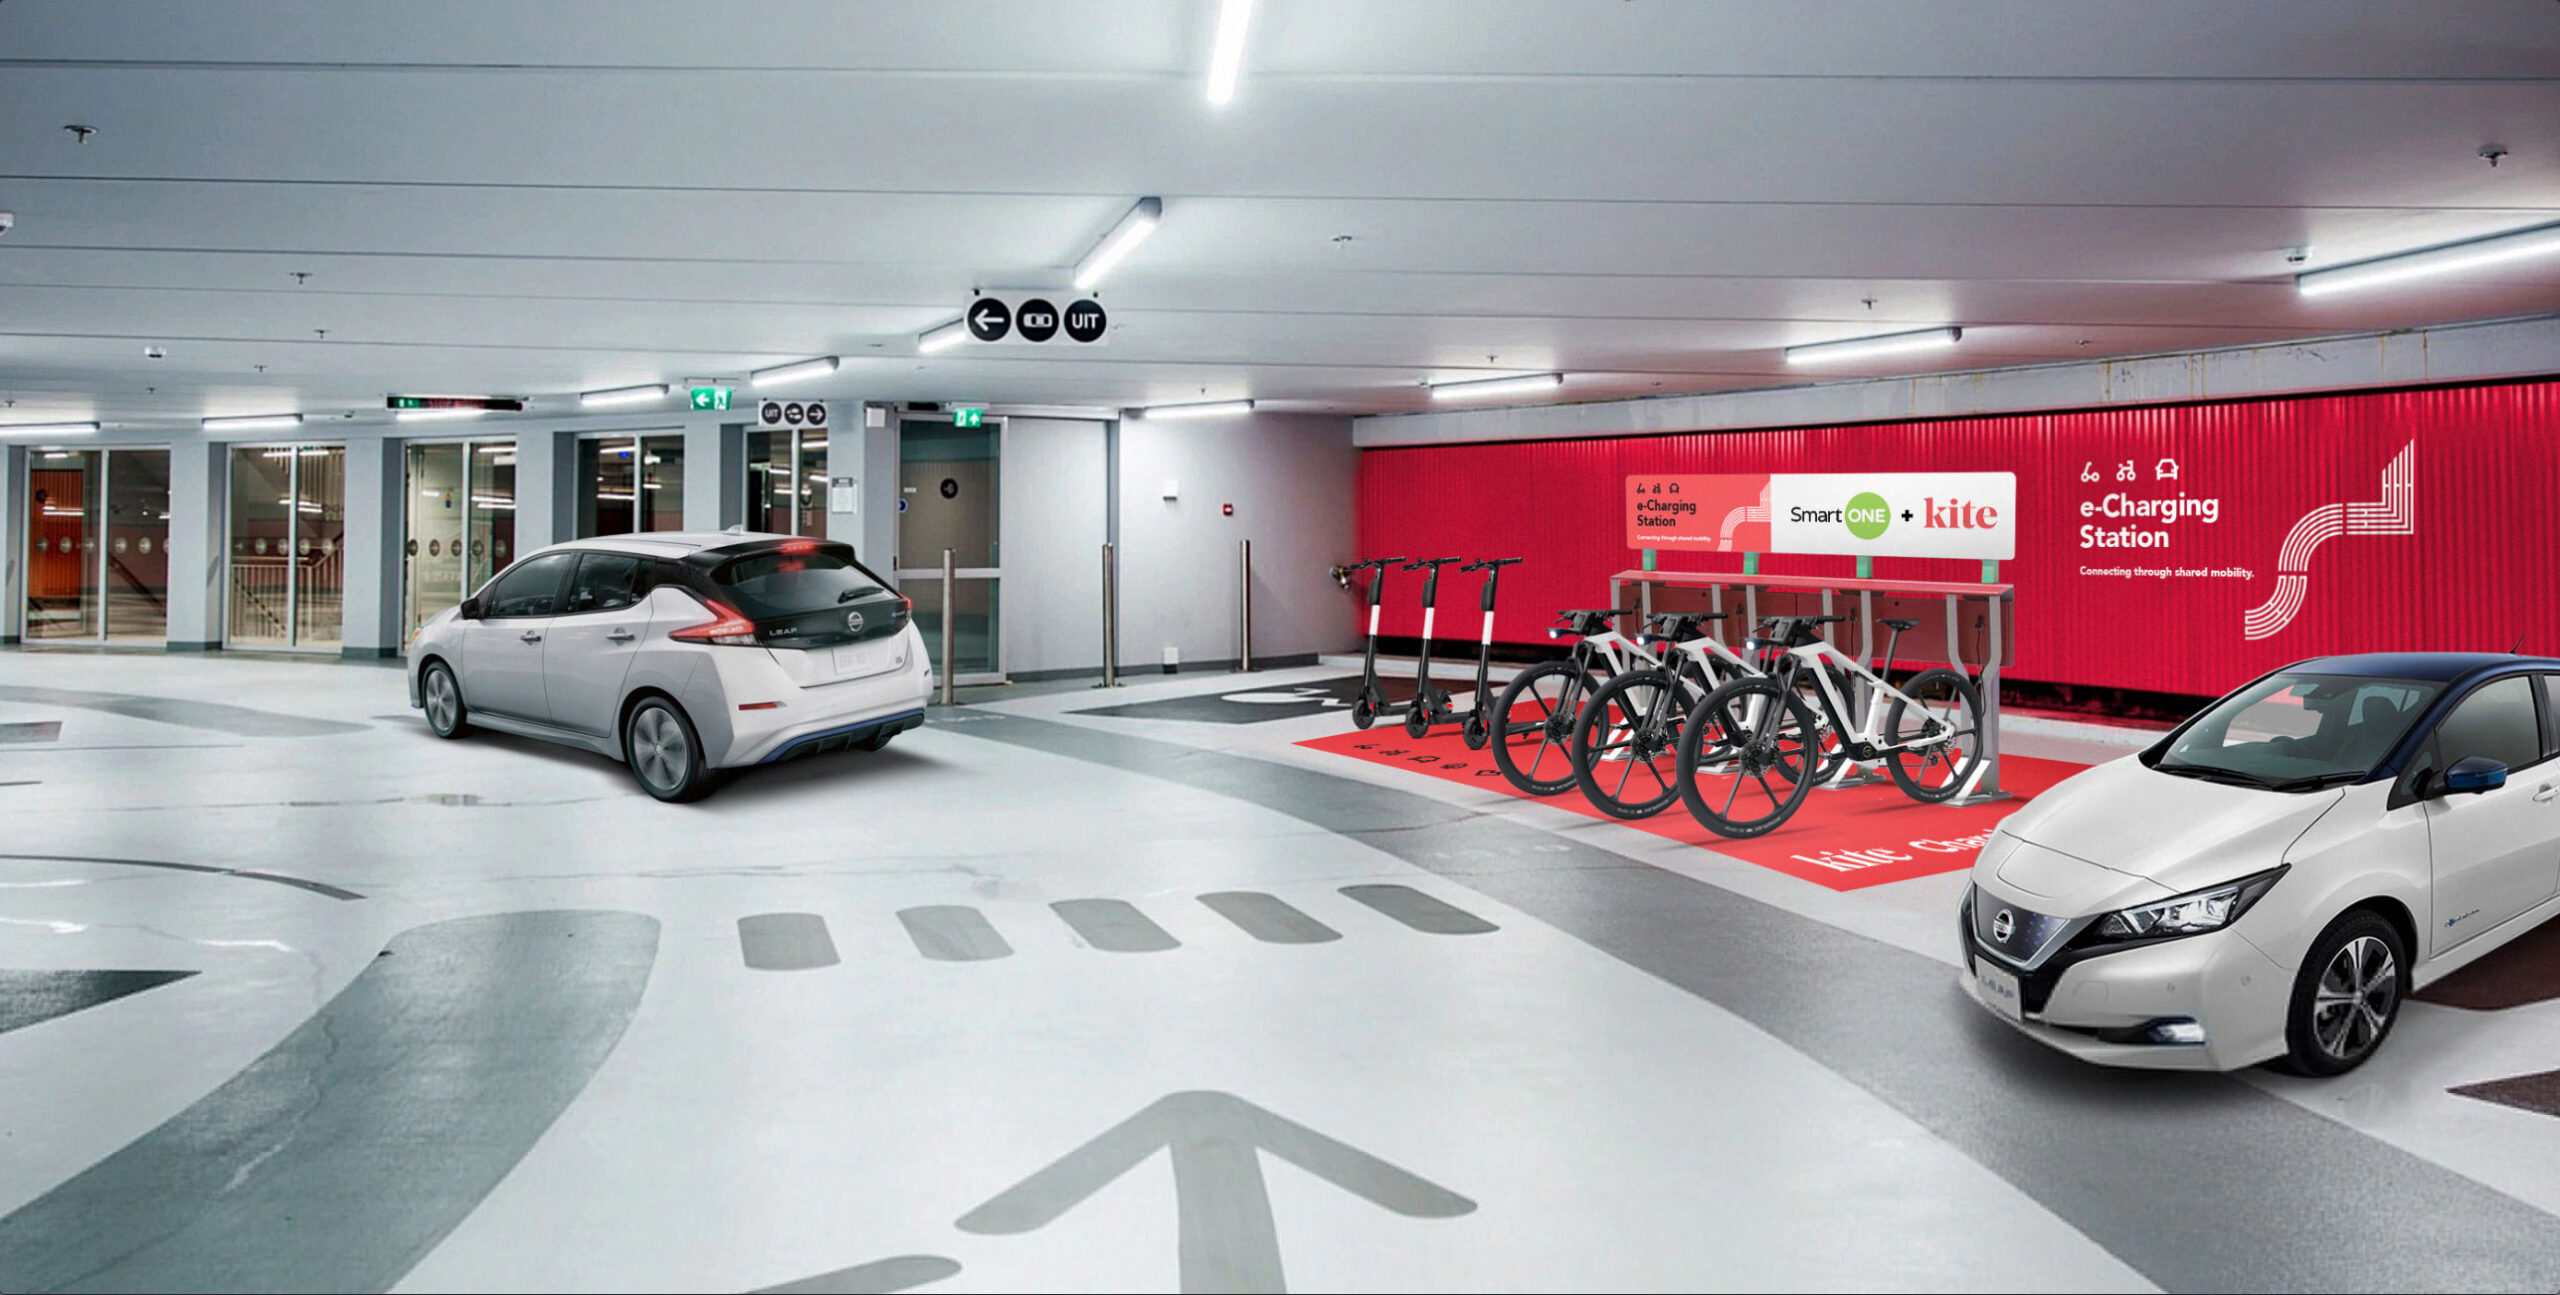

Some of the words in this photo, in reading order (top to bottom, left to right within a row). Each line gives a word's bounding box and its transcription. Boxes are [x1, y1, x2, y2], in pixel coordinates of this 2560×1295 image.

[1072, 313, 1099, 329] UIT
[765, 409, 779, 418] UIT
[1637, 499, 1697, 515] e-Charging
[1791, 506, 1842, 523] Smart
[1848, 508, 1886, 523] ONE
[1923, 497, 1998, 529] kite
[2080, 491, 2219, 524] e-Charging
[1637, 515, 1676, 527] Station
[2080, 524, 2169, 548] Station
[2080, 566, 2131, 579] Connecting
[2134, 567, 2172, 579] through
[2175, 567, 2208, 577] shared
[2211, 568, 2254, 580] mobility.
[769, 627, 797, 636] LEAF
[1790, 848, 1912, 872] kite
